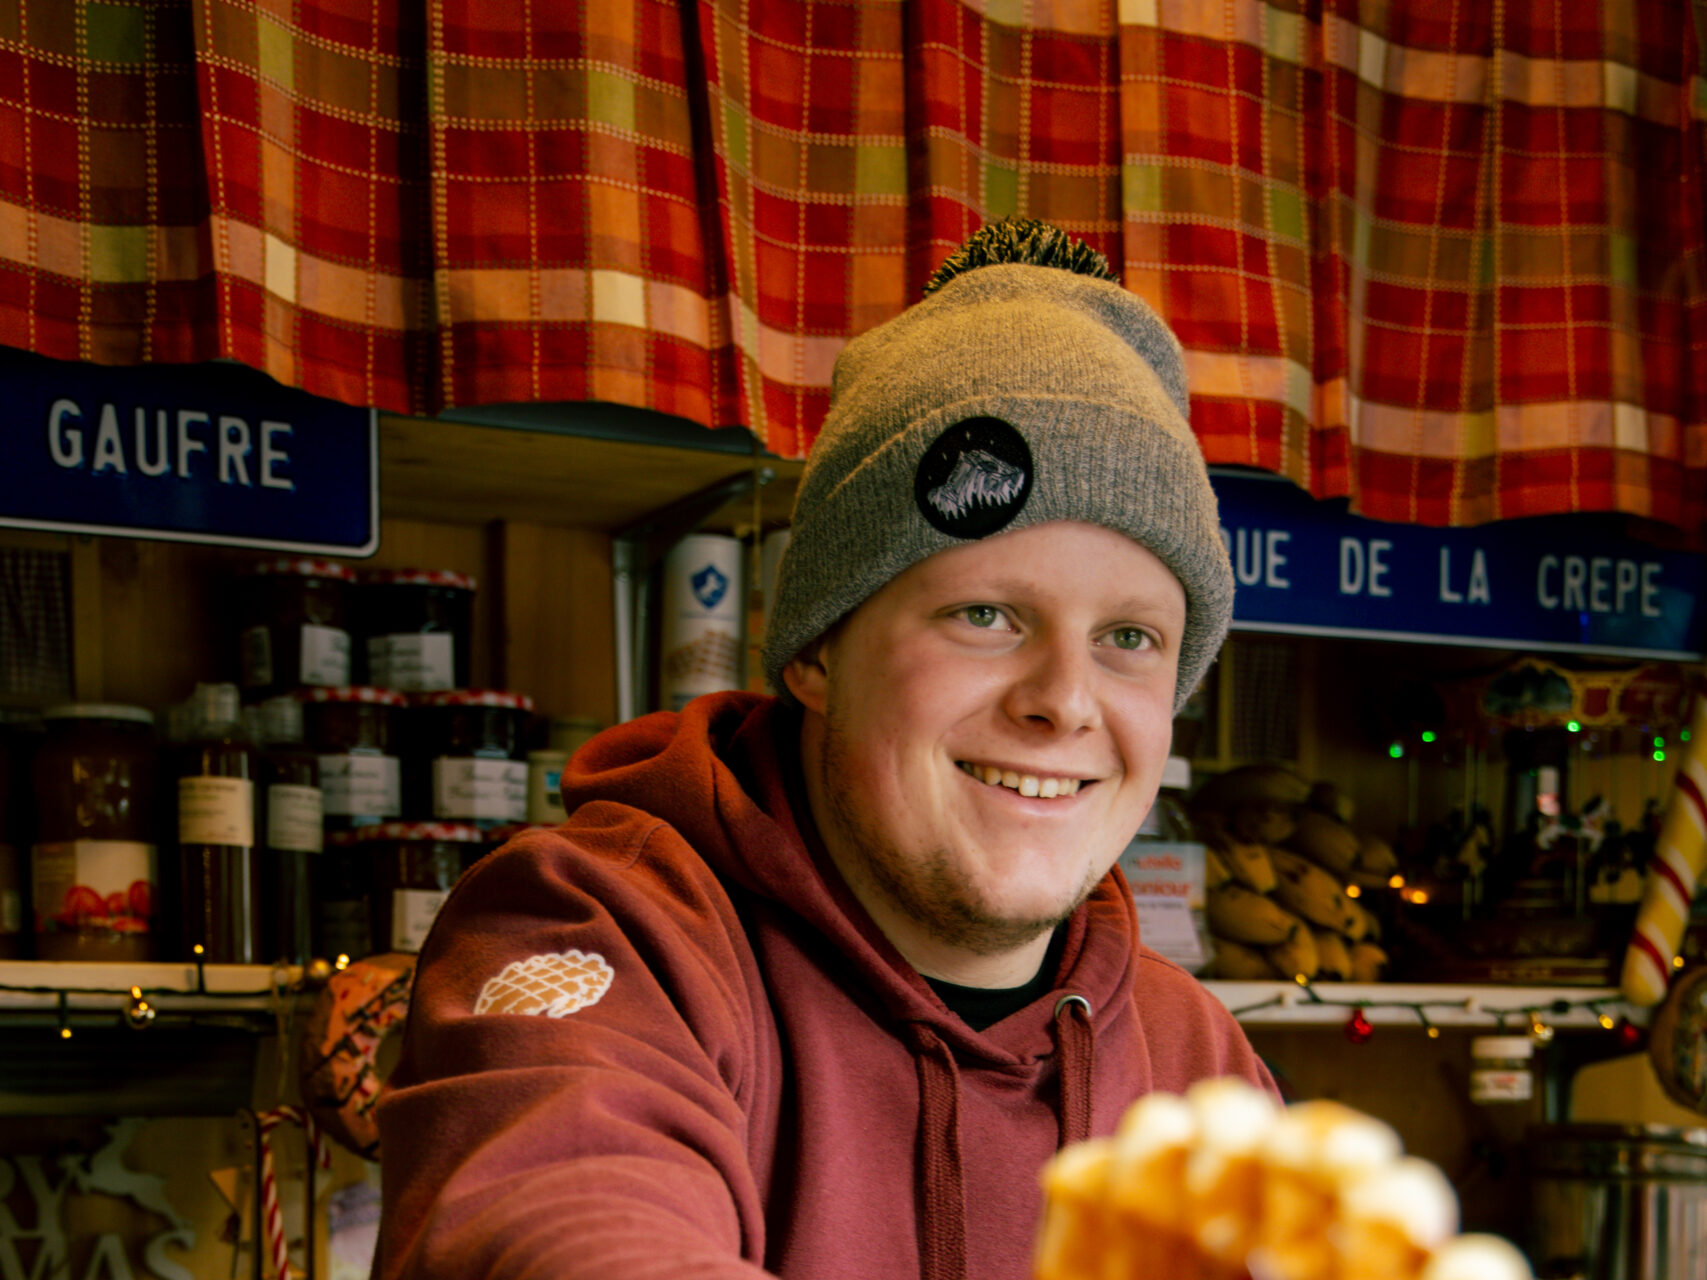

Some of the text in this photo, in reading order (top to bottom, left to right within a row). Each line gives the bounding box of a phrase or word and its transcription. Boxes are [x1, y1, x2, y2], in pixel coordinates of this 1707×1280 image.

[49, 399, 294, 490] GAUFRE
[1220, 526, 1662, 616] UE DE LA CREPE
